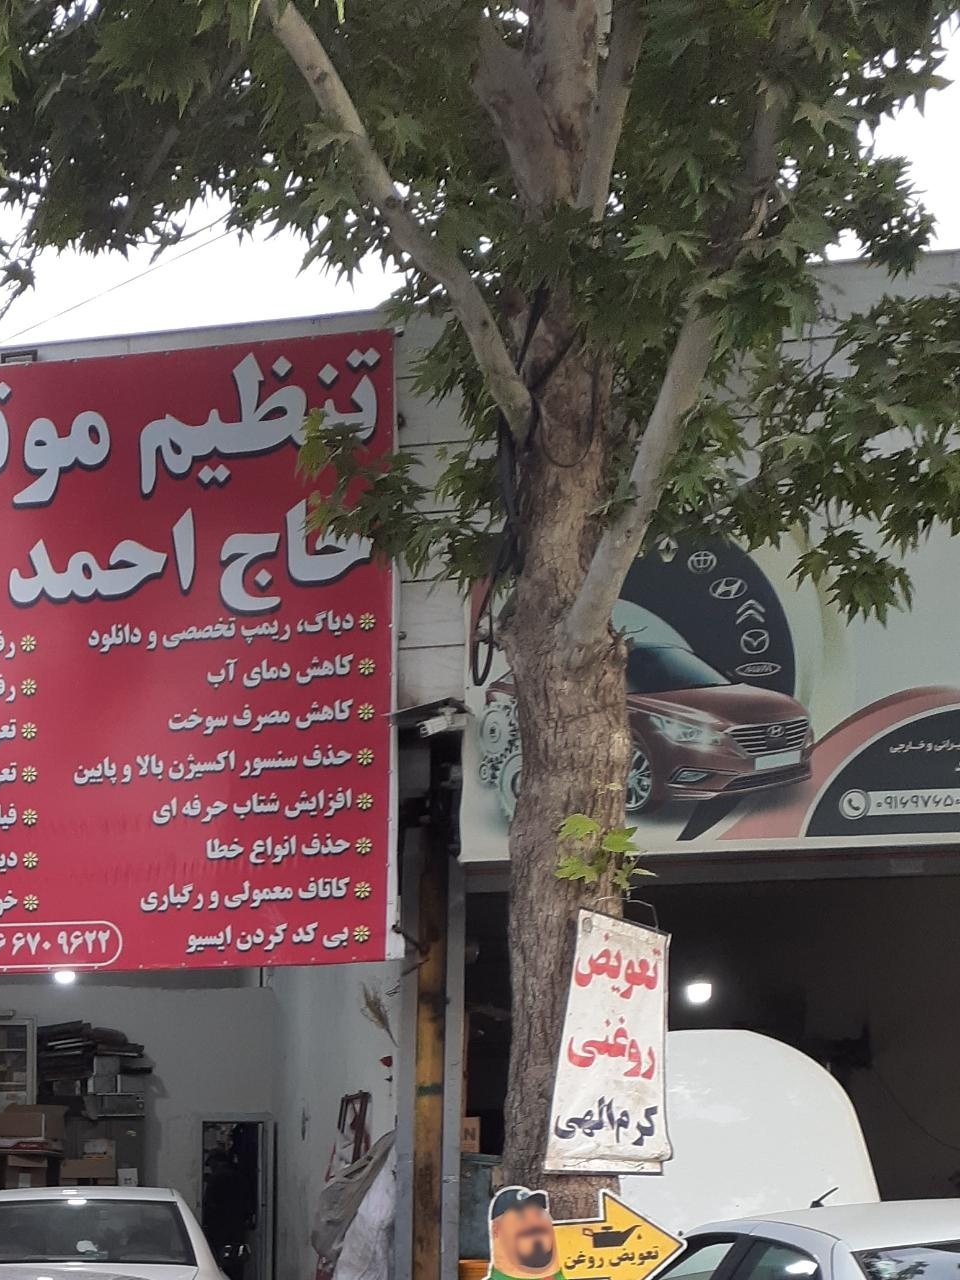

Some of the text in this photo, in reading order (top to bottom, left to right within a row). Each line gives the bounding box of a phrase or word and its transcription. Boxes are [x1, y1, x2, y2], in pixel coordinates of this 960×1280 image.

[140, 347, 381, 497] تنظیم
[8, 508, 194, 602] احمد
[219, 500, 373, 612] حاج
[88, 622, 142, 652] دانلود
[147, 629, 157, 650] و
[162, 617, 236, 648] تخصصی
[241, 617, 290, 644] ریمپ
[207, 654, 354, 688] کاهش دمای آب
[168, 698, 354, 735] کاهش مصرف سوخت
[73, 744, 353, 786] حذف سنسور اکسیژن بالا و پایین
[152, 787, 352, 825] افزایش شتاب حرفه ای
[205, 833, 350, 864] حذف انواع خطا
[140, 876, 350, 911] کاتاف معمولی و رگباری
[186, 922, 350, 953] بی کد کردن ایسیو
[574, 933, 662, 1000] تعویض
[567, 1016, 656, 1080] روغنی
[563, 1245, 659, 1270] تعویض روغن
